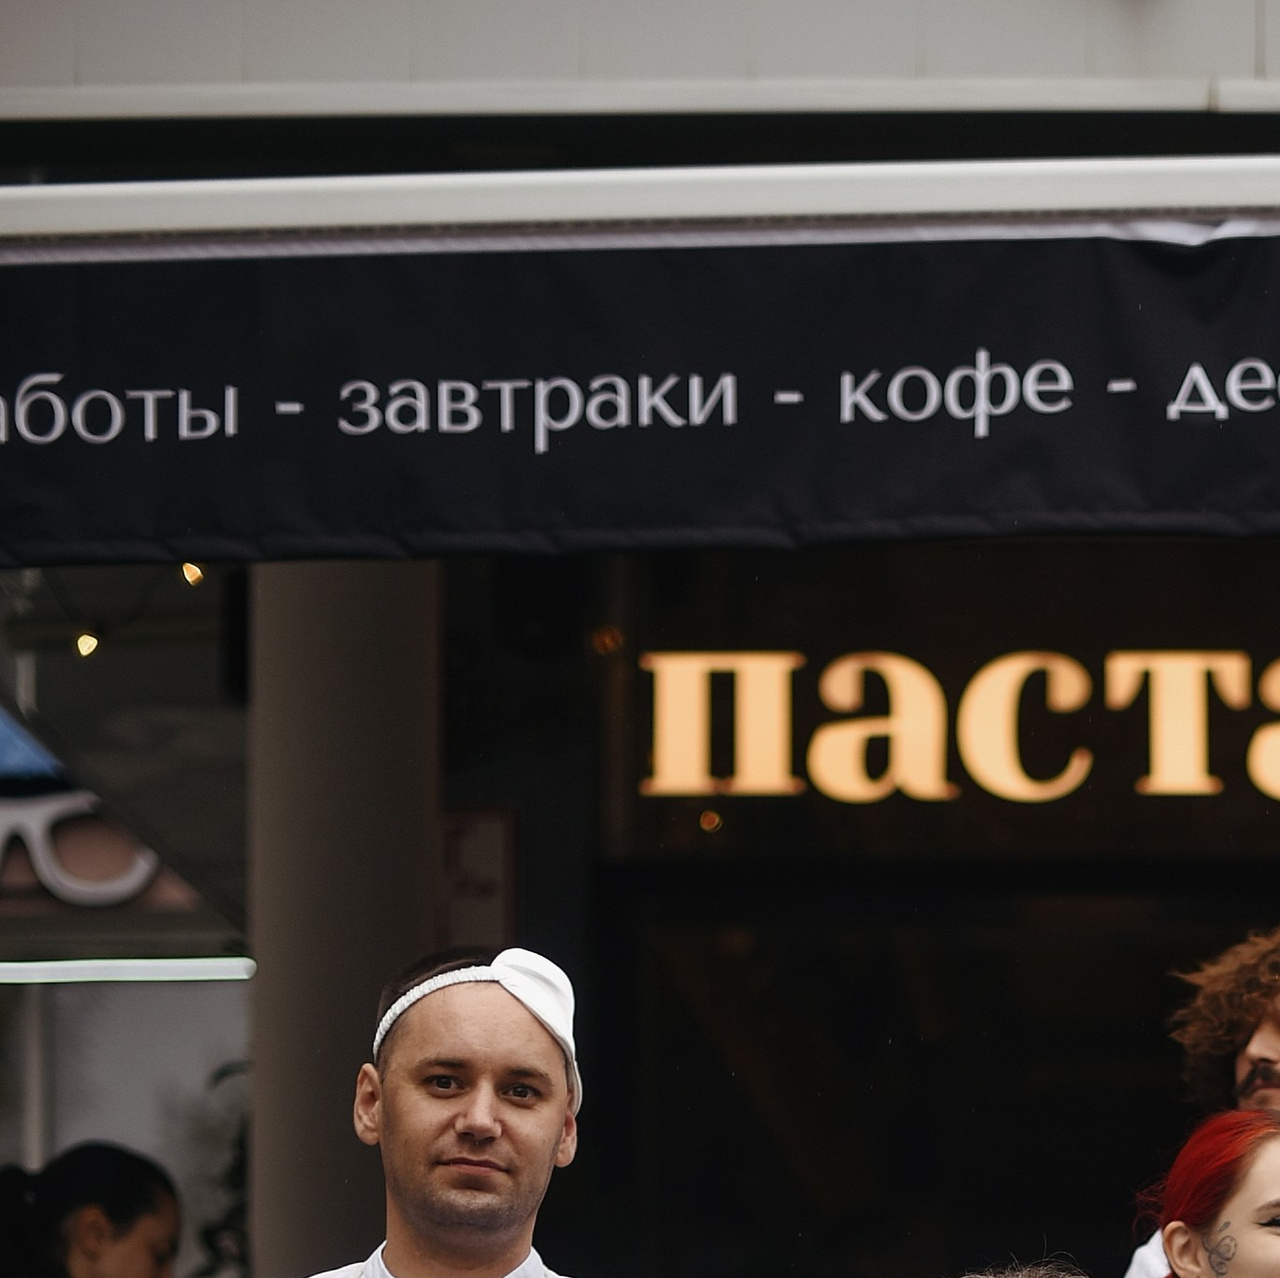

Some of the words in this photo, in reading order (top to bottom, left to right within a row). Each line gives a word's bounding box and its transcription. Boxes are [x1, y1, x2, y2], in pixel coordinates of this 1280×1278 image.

[0, 374, 238, 443] боты
[338, 373, 738, 454] завтраки
[840, 348, 1074, 438] кофе
